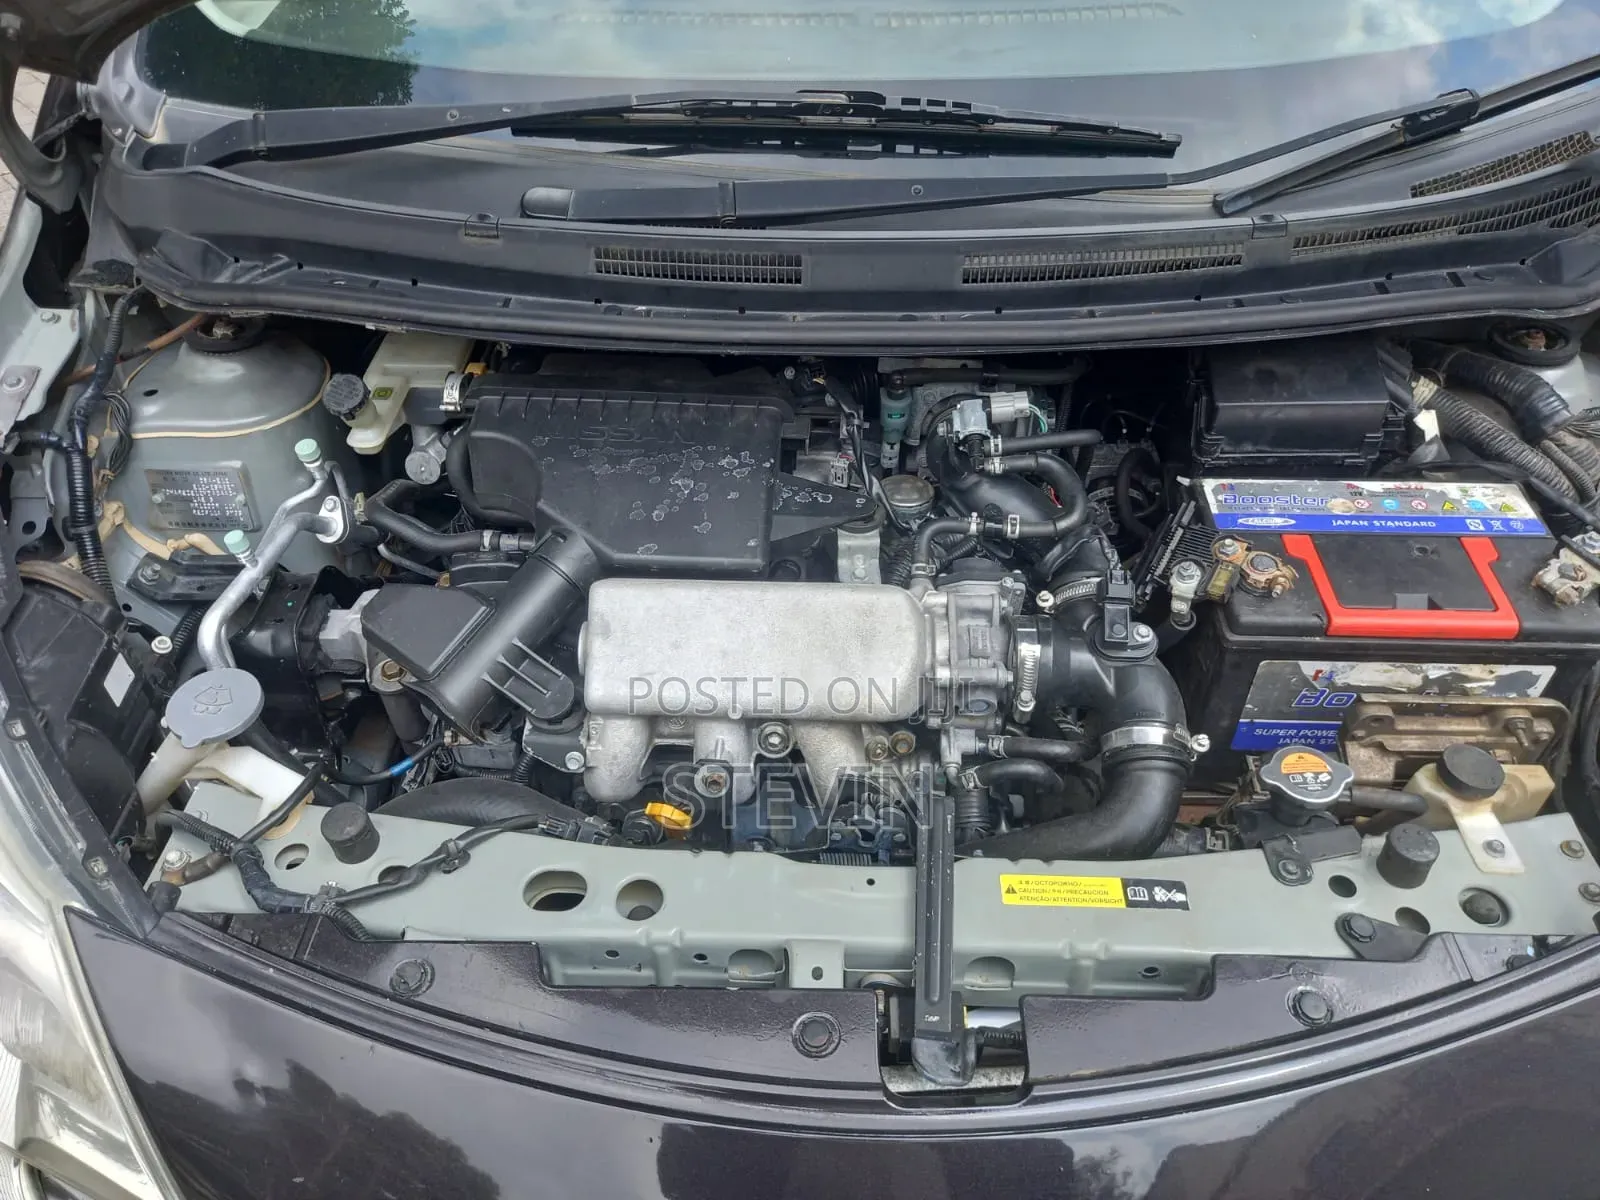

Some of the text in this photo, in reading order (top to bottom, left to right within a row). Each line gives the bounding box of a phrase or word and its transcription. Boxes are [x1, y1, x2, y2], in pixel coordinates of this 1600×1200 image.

[1223, 493, 1329, 506] Booster
[1331, 519, 1437, 528] JAPAN STANDARD
[1291, 687, 1357, 708] Bo
[1254, 728, 1338, 738] SUPER POWE
